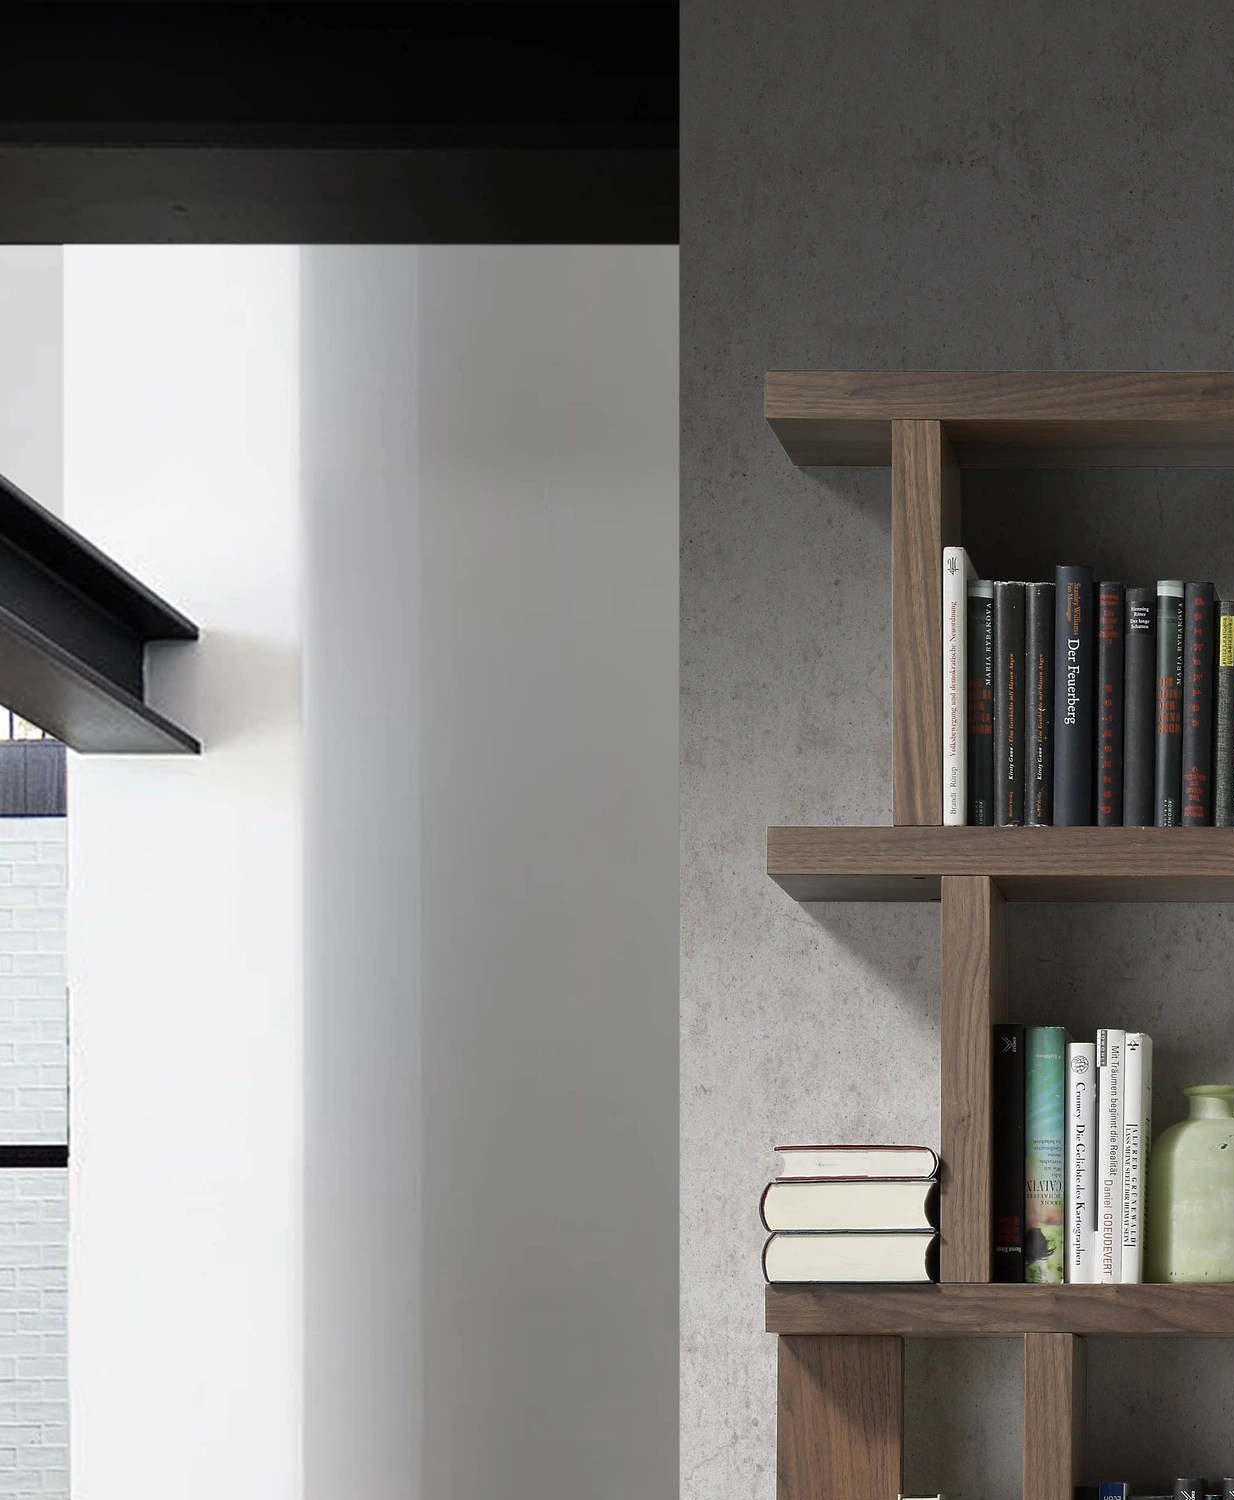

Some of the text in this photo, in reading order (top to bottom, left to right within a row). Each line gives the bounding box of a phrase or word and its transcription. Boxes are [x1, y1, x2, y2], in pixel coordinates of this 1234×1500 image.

[1073, 582, 1081, 635] Stanley Williams
[1176, 602, 1184, 686] MARIA RYBAKOVA
[949, 601, 958, 757] Volksbewegung und demokratische Neuordnung
[1064, 639, 1080, 725] Der Feuerberg
[948, 766, 958, 815] Brandt Rürup
[1108, 1045, 1120, 1176] Mit Träumen beginnt die Realität
[1073, 1081, 1086, 1266] Crumey Die Geliebte des Kartographen
[1130, 1177, 1138, 1243] GRÜNEWALD
[1103, 1179, 1113, 1276] Daniel GOEUDEVERT
